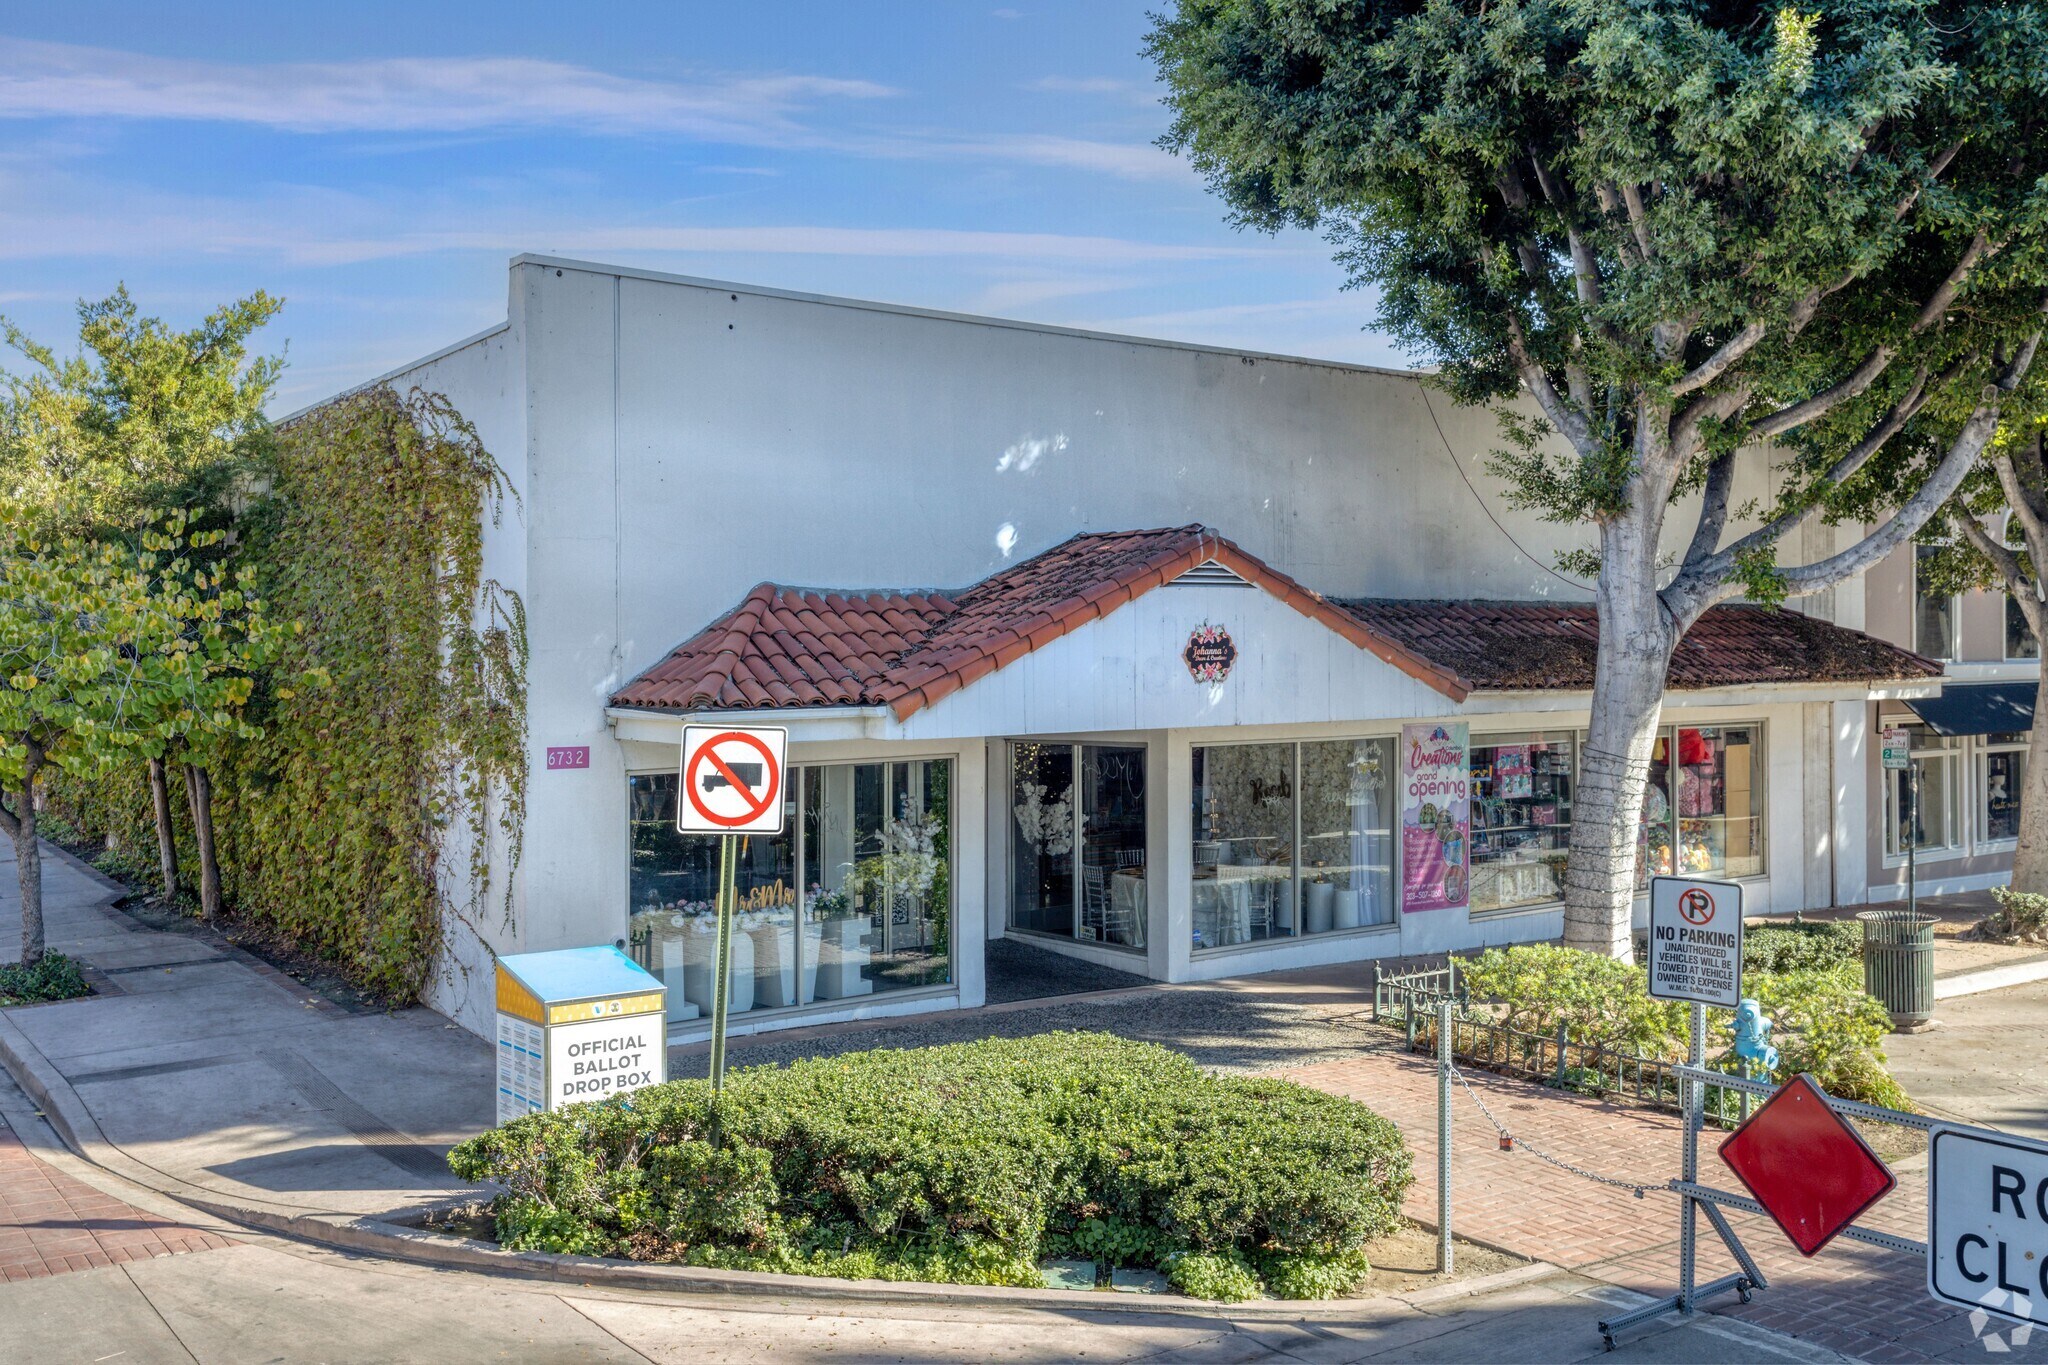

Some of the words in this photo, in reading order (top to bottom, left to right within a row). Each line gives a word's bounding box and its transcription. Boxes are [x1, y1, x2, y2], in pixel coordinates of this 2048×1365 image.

[548, 750, 584, 766] 6732
[1411, 744, 1464, 770] Creations
[1416, 770, 1438, 784] grand
[1408, 776, 1466, 803] opening
[1656, 925, 1675, 941] NO
[1680, 927, 1735, 949] PARKING
[1659, 952, 1698, 965] VEHICLES
[1700, 957, 1719, 968] WILL
[1721, 960, 1732, 970] BE
[1664, 942, 1727, 959] UNAUTHORIZED
[1657, 962, 1687, 974] TOWED
[1689, 965, 1699, 975] AT
[1701, 967, 1733, 981] VEHICLE
[1657, 972, 1696, 986] OWNER'S
[1697, 976, 1733, 991] EXPENSE
[567, 1034, 647, 1057] OFFICIAL
[573, 1054, 642, 1076] BALLOT
[563, 1077, 612, 1096] DROP
[616, 1070, 652, 1088] BOX
[1956, 1232, 2048, 1300] CL
